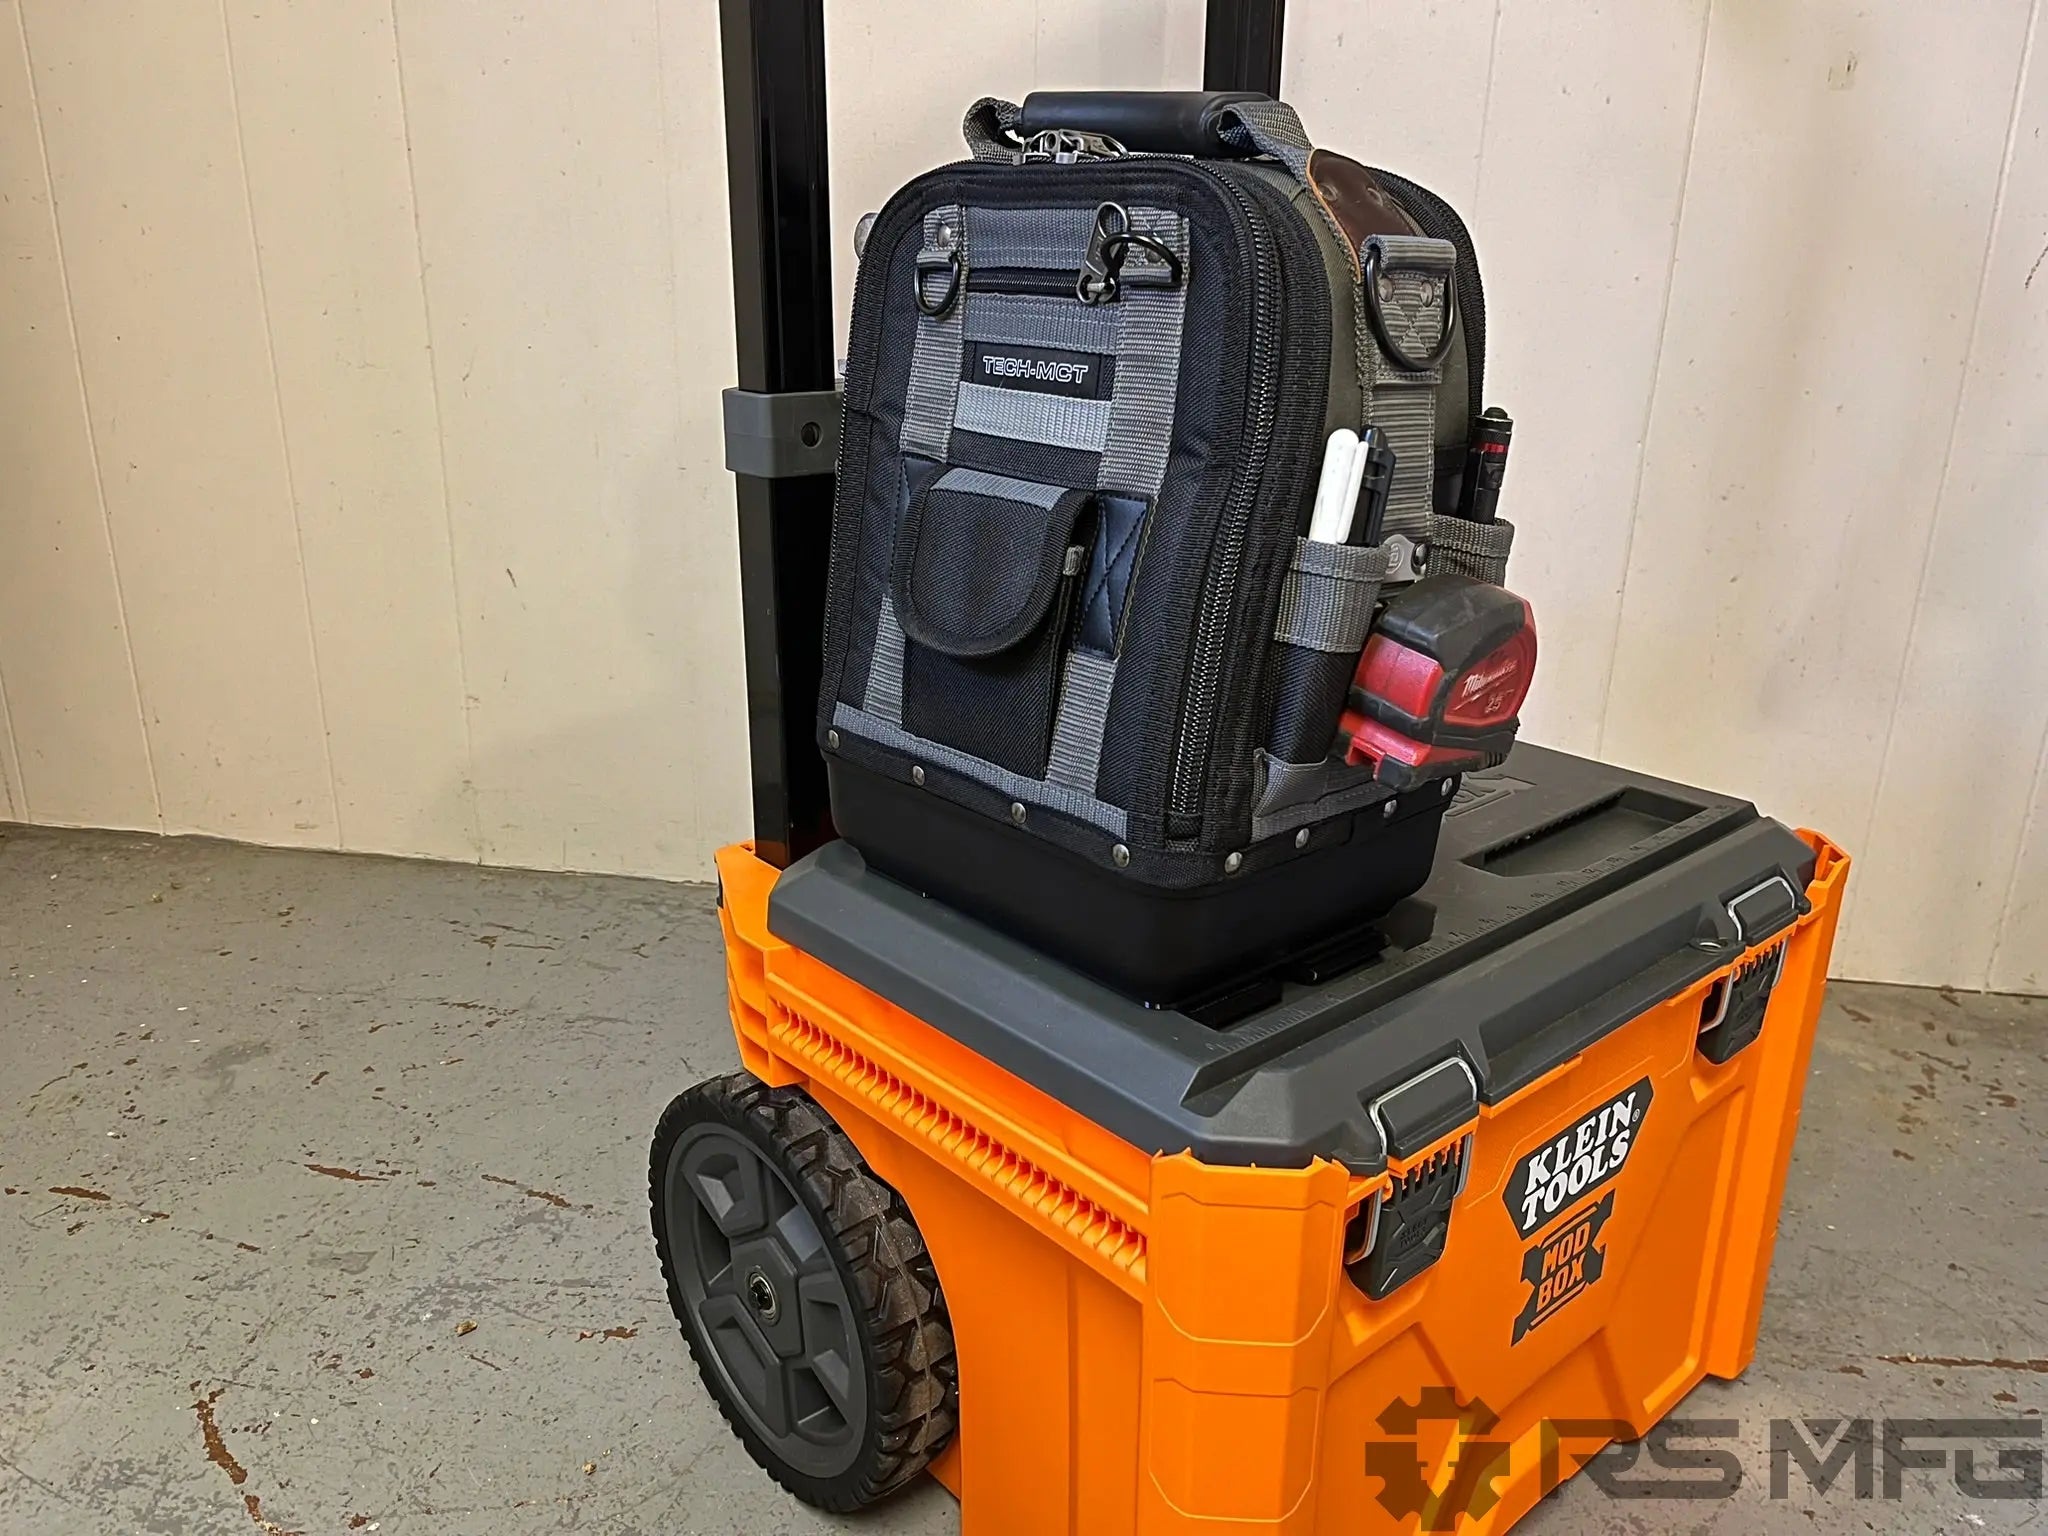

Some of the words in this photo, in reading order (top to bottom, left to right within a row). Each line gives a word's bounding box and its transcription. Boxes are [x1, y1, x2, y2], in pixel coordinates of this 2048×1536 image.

[982, 355, 1089, 384] TECH-MCT
[1524, 1092, 1637, 1196] KLEIN
[1521, 1128, 1631, 1231] TOOLS
[1540, 1221, 1591, 1280] MOD
[1536, 1251, 1587, 1313] BOX
